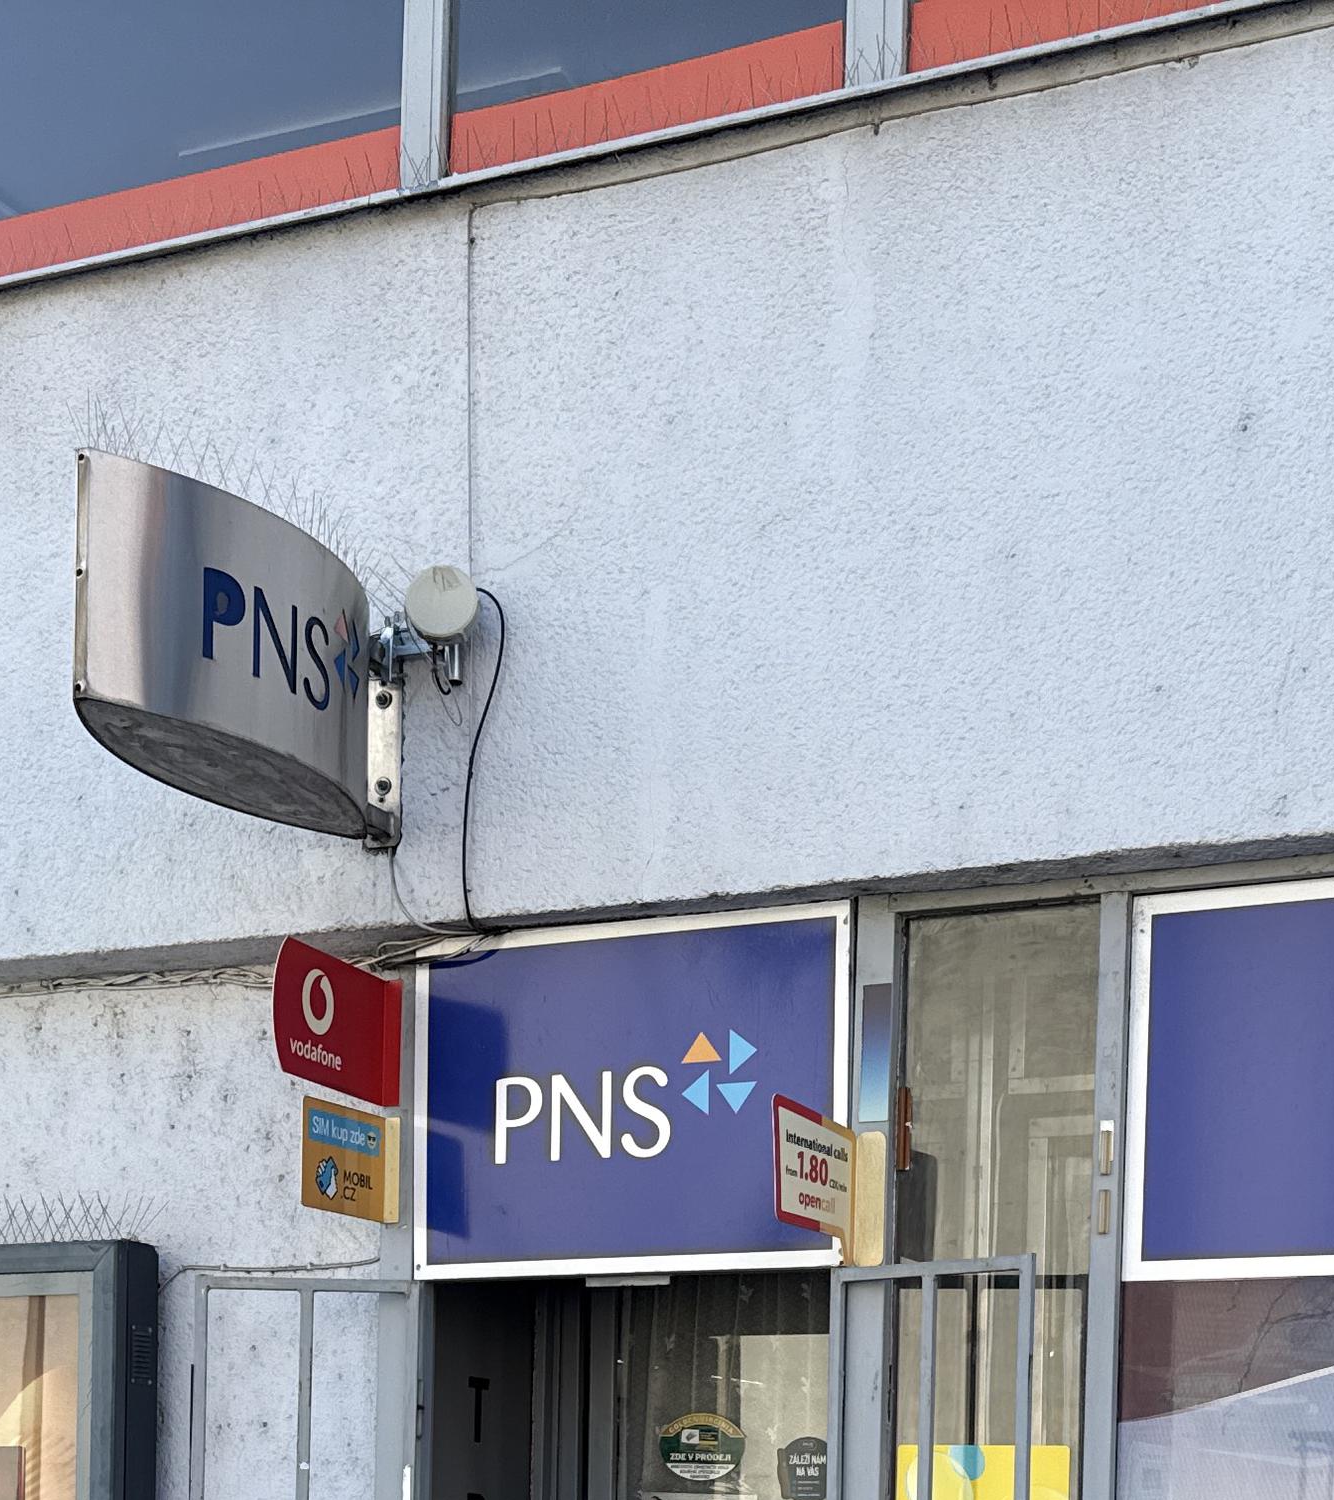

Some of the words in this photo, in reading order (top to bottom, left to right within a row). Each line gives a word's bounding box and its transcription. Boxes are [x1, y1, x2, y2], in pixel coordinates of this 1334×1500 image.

[201, 566, 330, 711] PNS
[289, 1037, 343, 1071] vodafone
[311, 1114, 330, 1137] SIM
[330, 1119, 349, 1145] kup
[349, 1127, 366, 1147] zde
[493, 1064, 673, 1166] PNS
[785, 1128, 833, 1157] International
[342, 1168, 374, 1191] MOBIL
[797, 1150, 829, 1186] 1.80
[340, 1184, 357, 1202] .CZ
